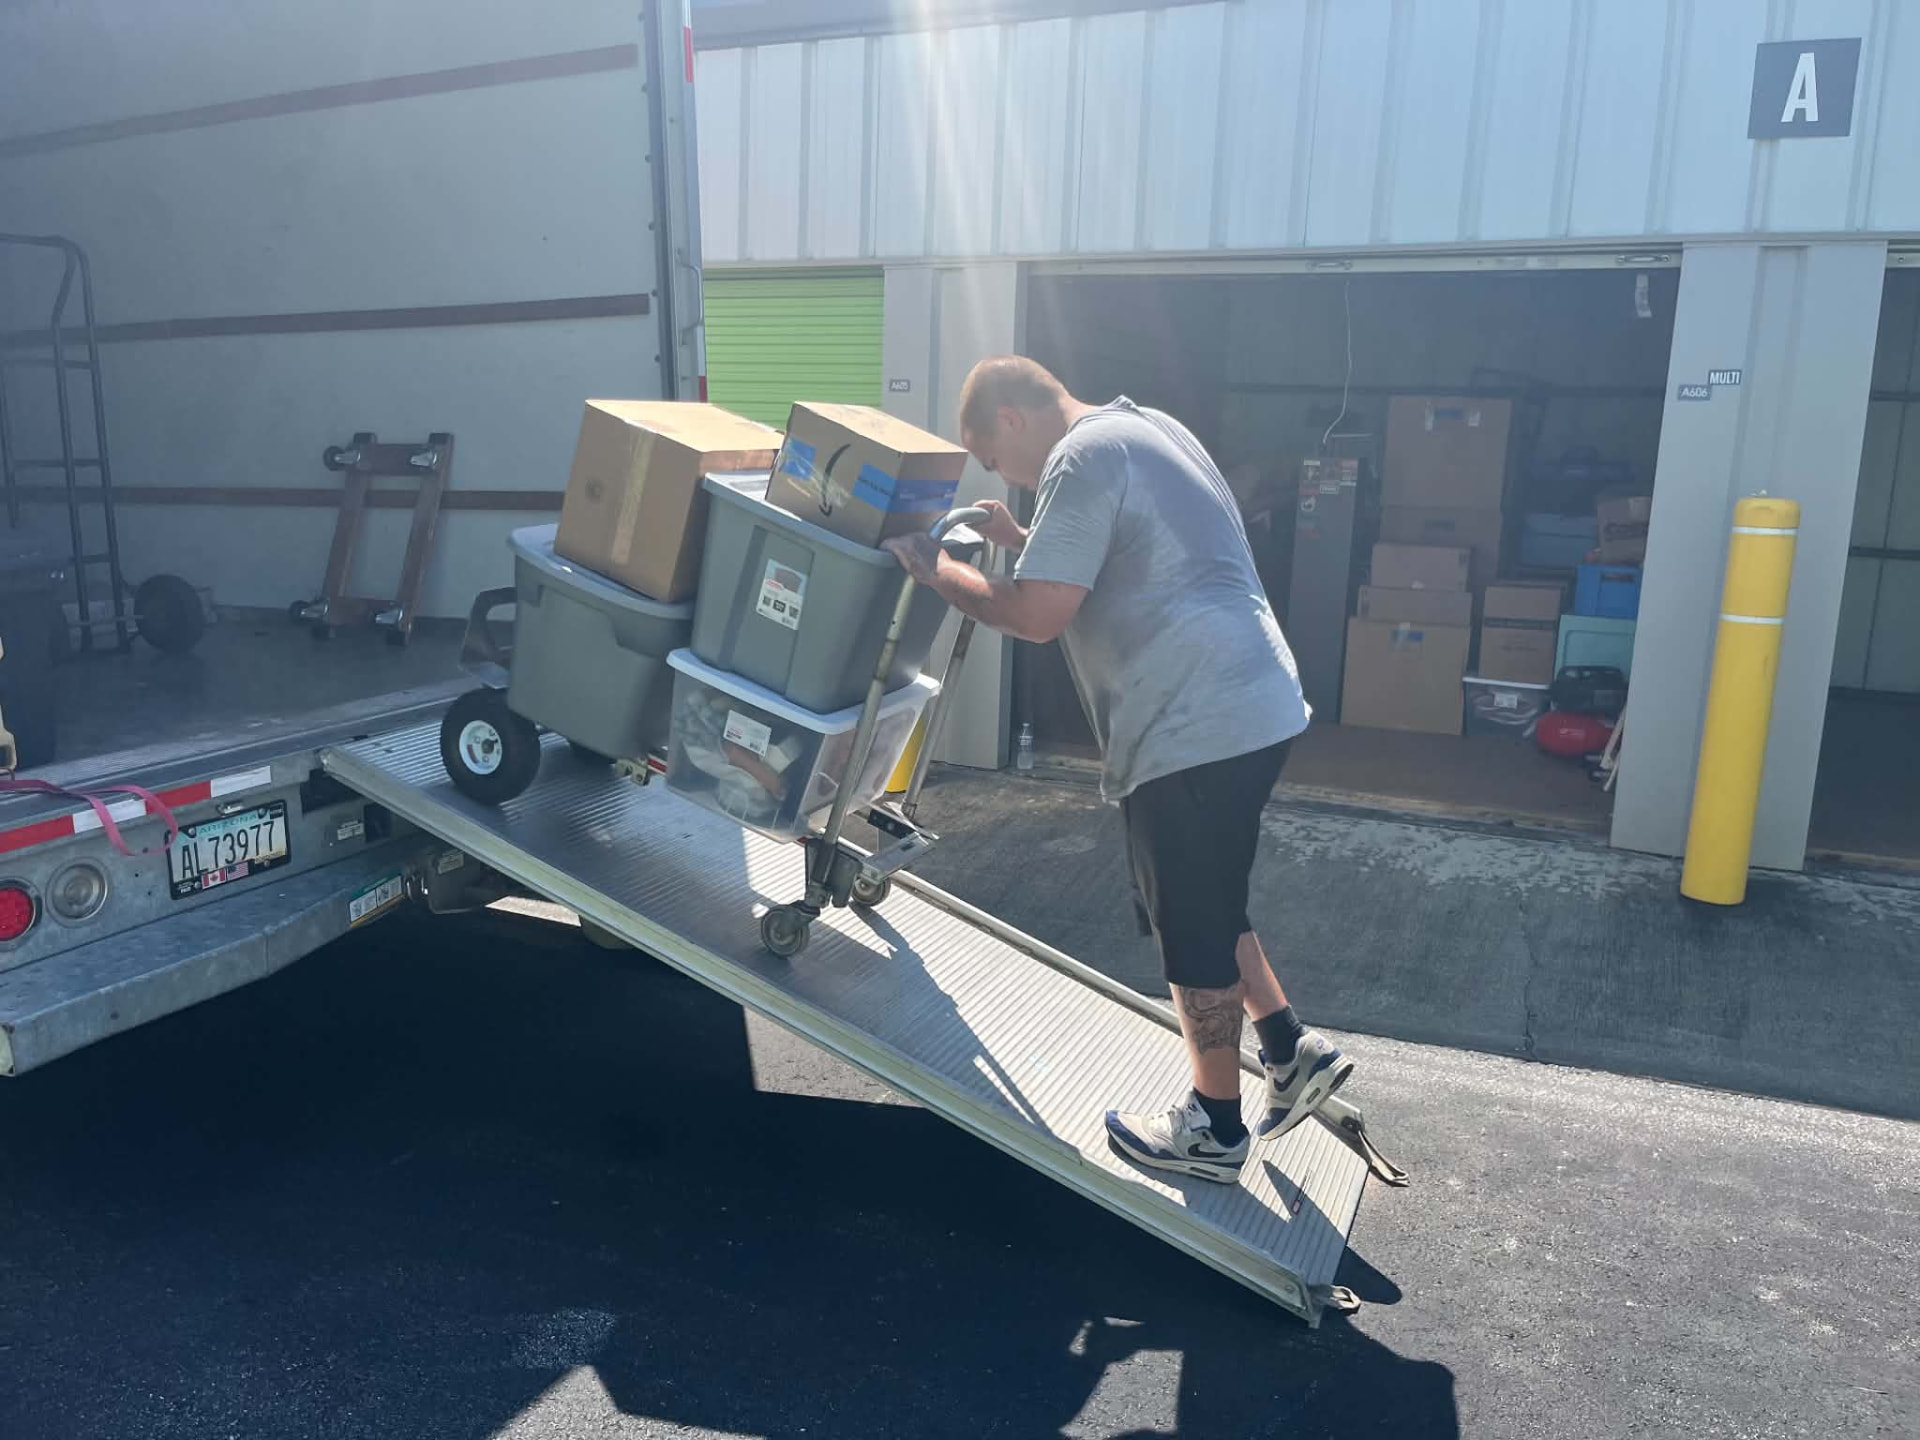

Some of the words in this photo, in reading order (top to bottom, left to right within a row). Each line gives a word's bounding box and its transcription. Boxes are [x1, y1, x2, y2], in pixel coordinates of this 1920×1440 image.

[1781, 52, 1819, 123] A
[1710, 371, 1740, 385] MULTI
[1680, 387, 1708, 398] A606
